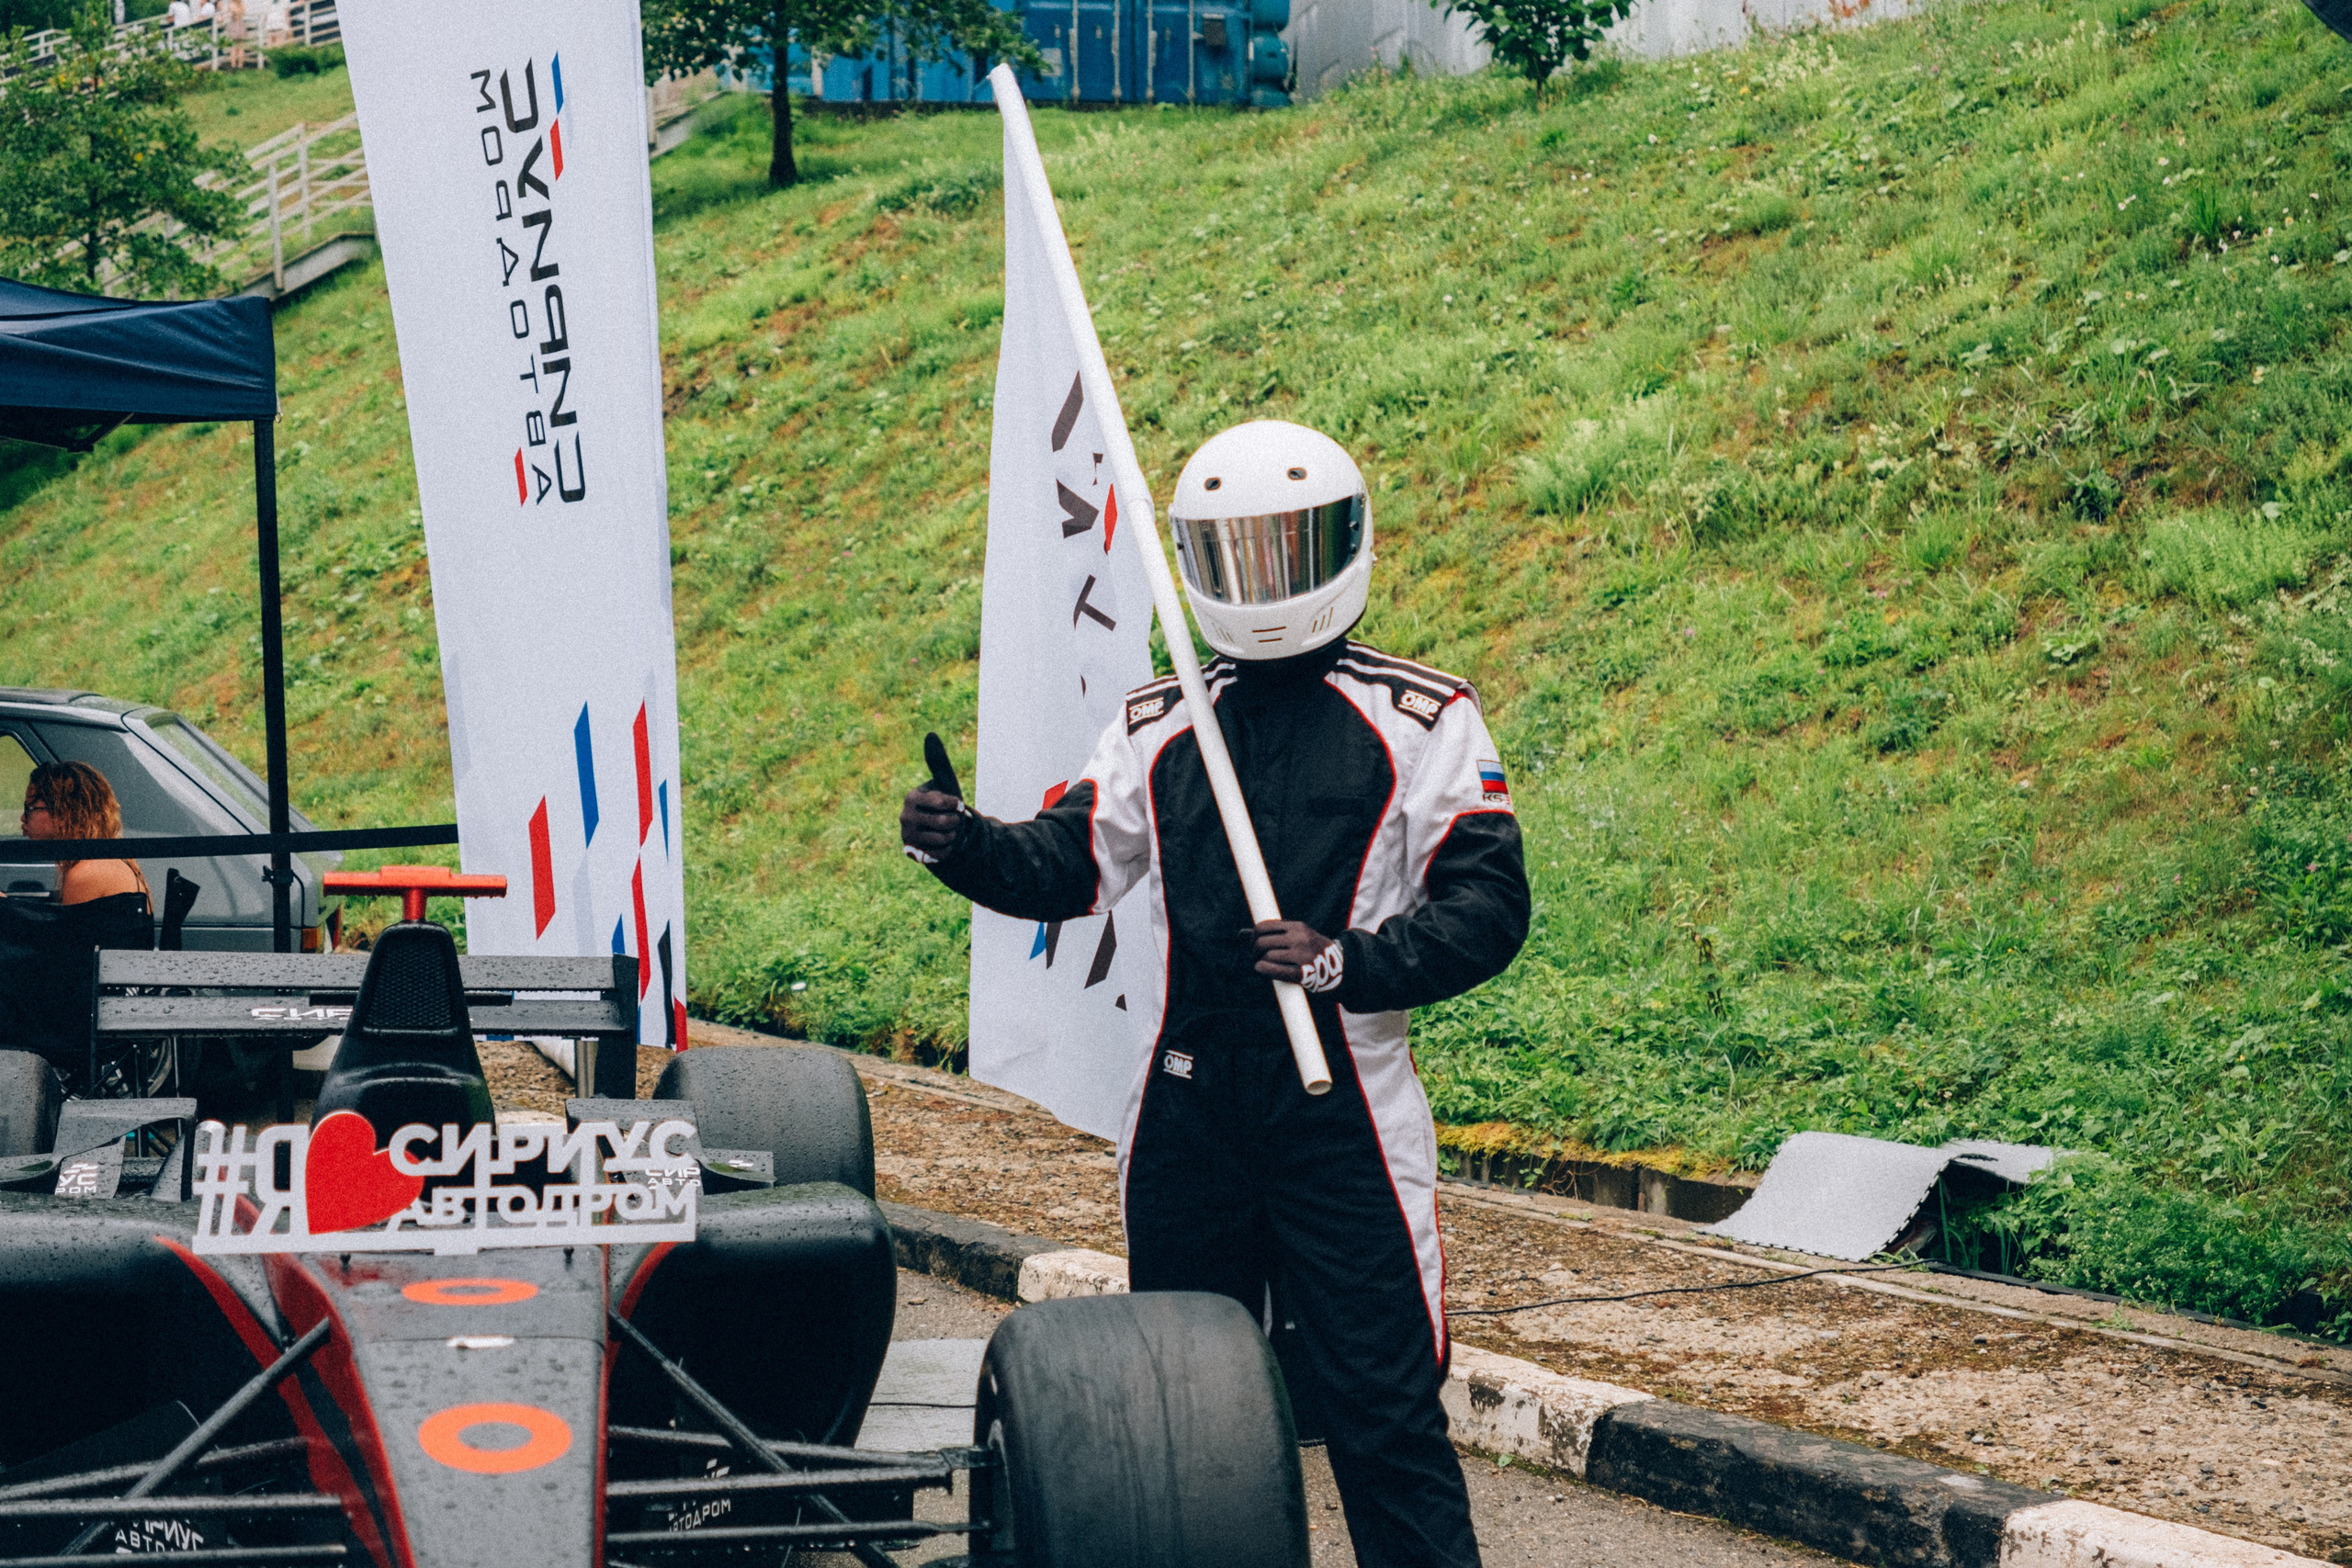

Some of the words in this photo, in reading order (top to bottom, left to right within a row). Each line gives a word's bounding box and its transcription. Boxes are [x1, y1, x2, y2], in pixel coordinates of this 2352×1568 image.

[1129, 699, 1164, 721] OMP
[1401, 693, 1439, 716] OMP
[251, 1008, 354, 1018] СИР
[1163, 1054, 1193, 1075] OMP
[389, 1121, 697, 1177] СИРИУС
[385, 1183, 696, 1231] АВТОДРОМ
